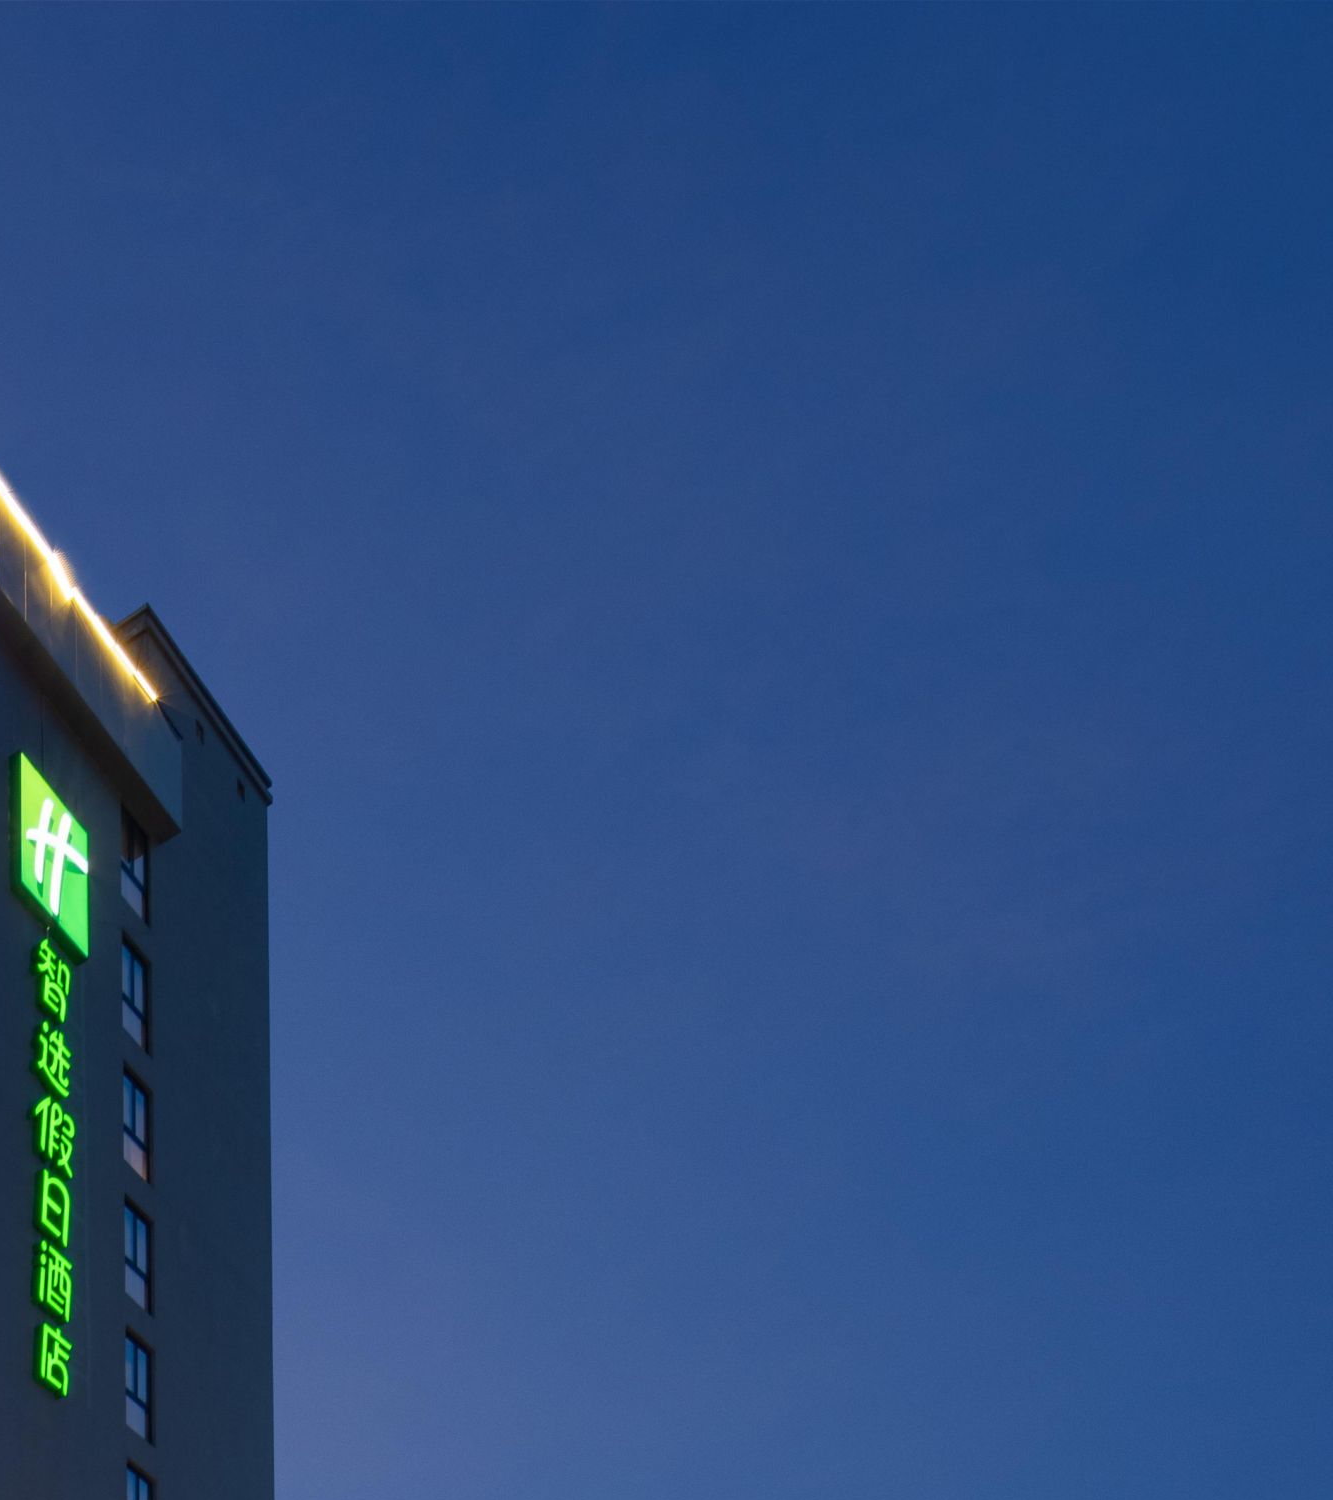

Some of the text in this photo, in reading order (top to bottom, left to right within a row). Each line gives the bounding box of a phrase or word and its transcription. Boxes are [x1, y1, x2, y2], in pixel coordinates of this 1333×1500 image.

[34, 937, 75, 1398] 智选假日酒店
